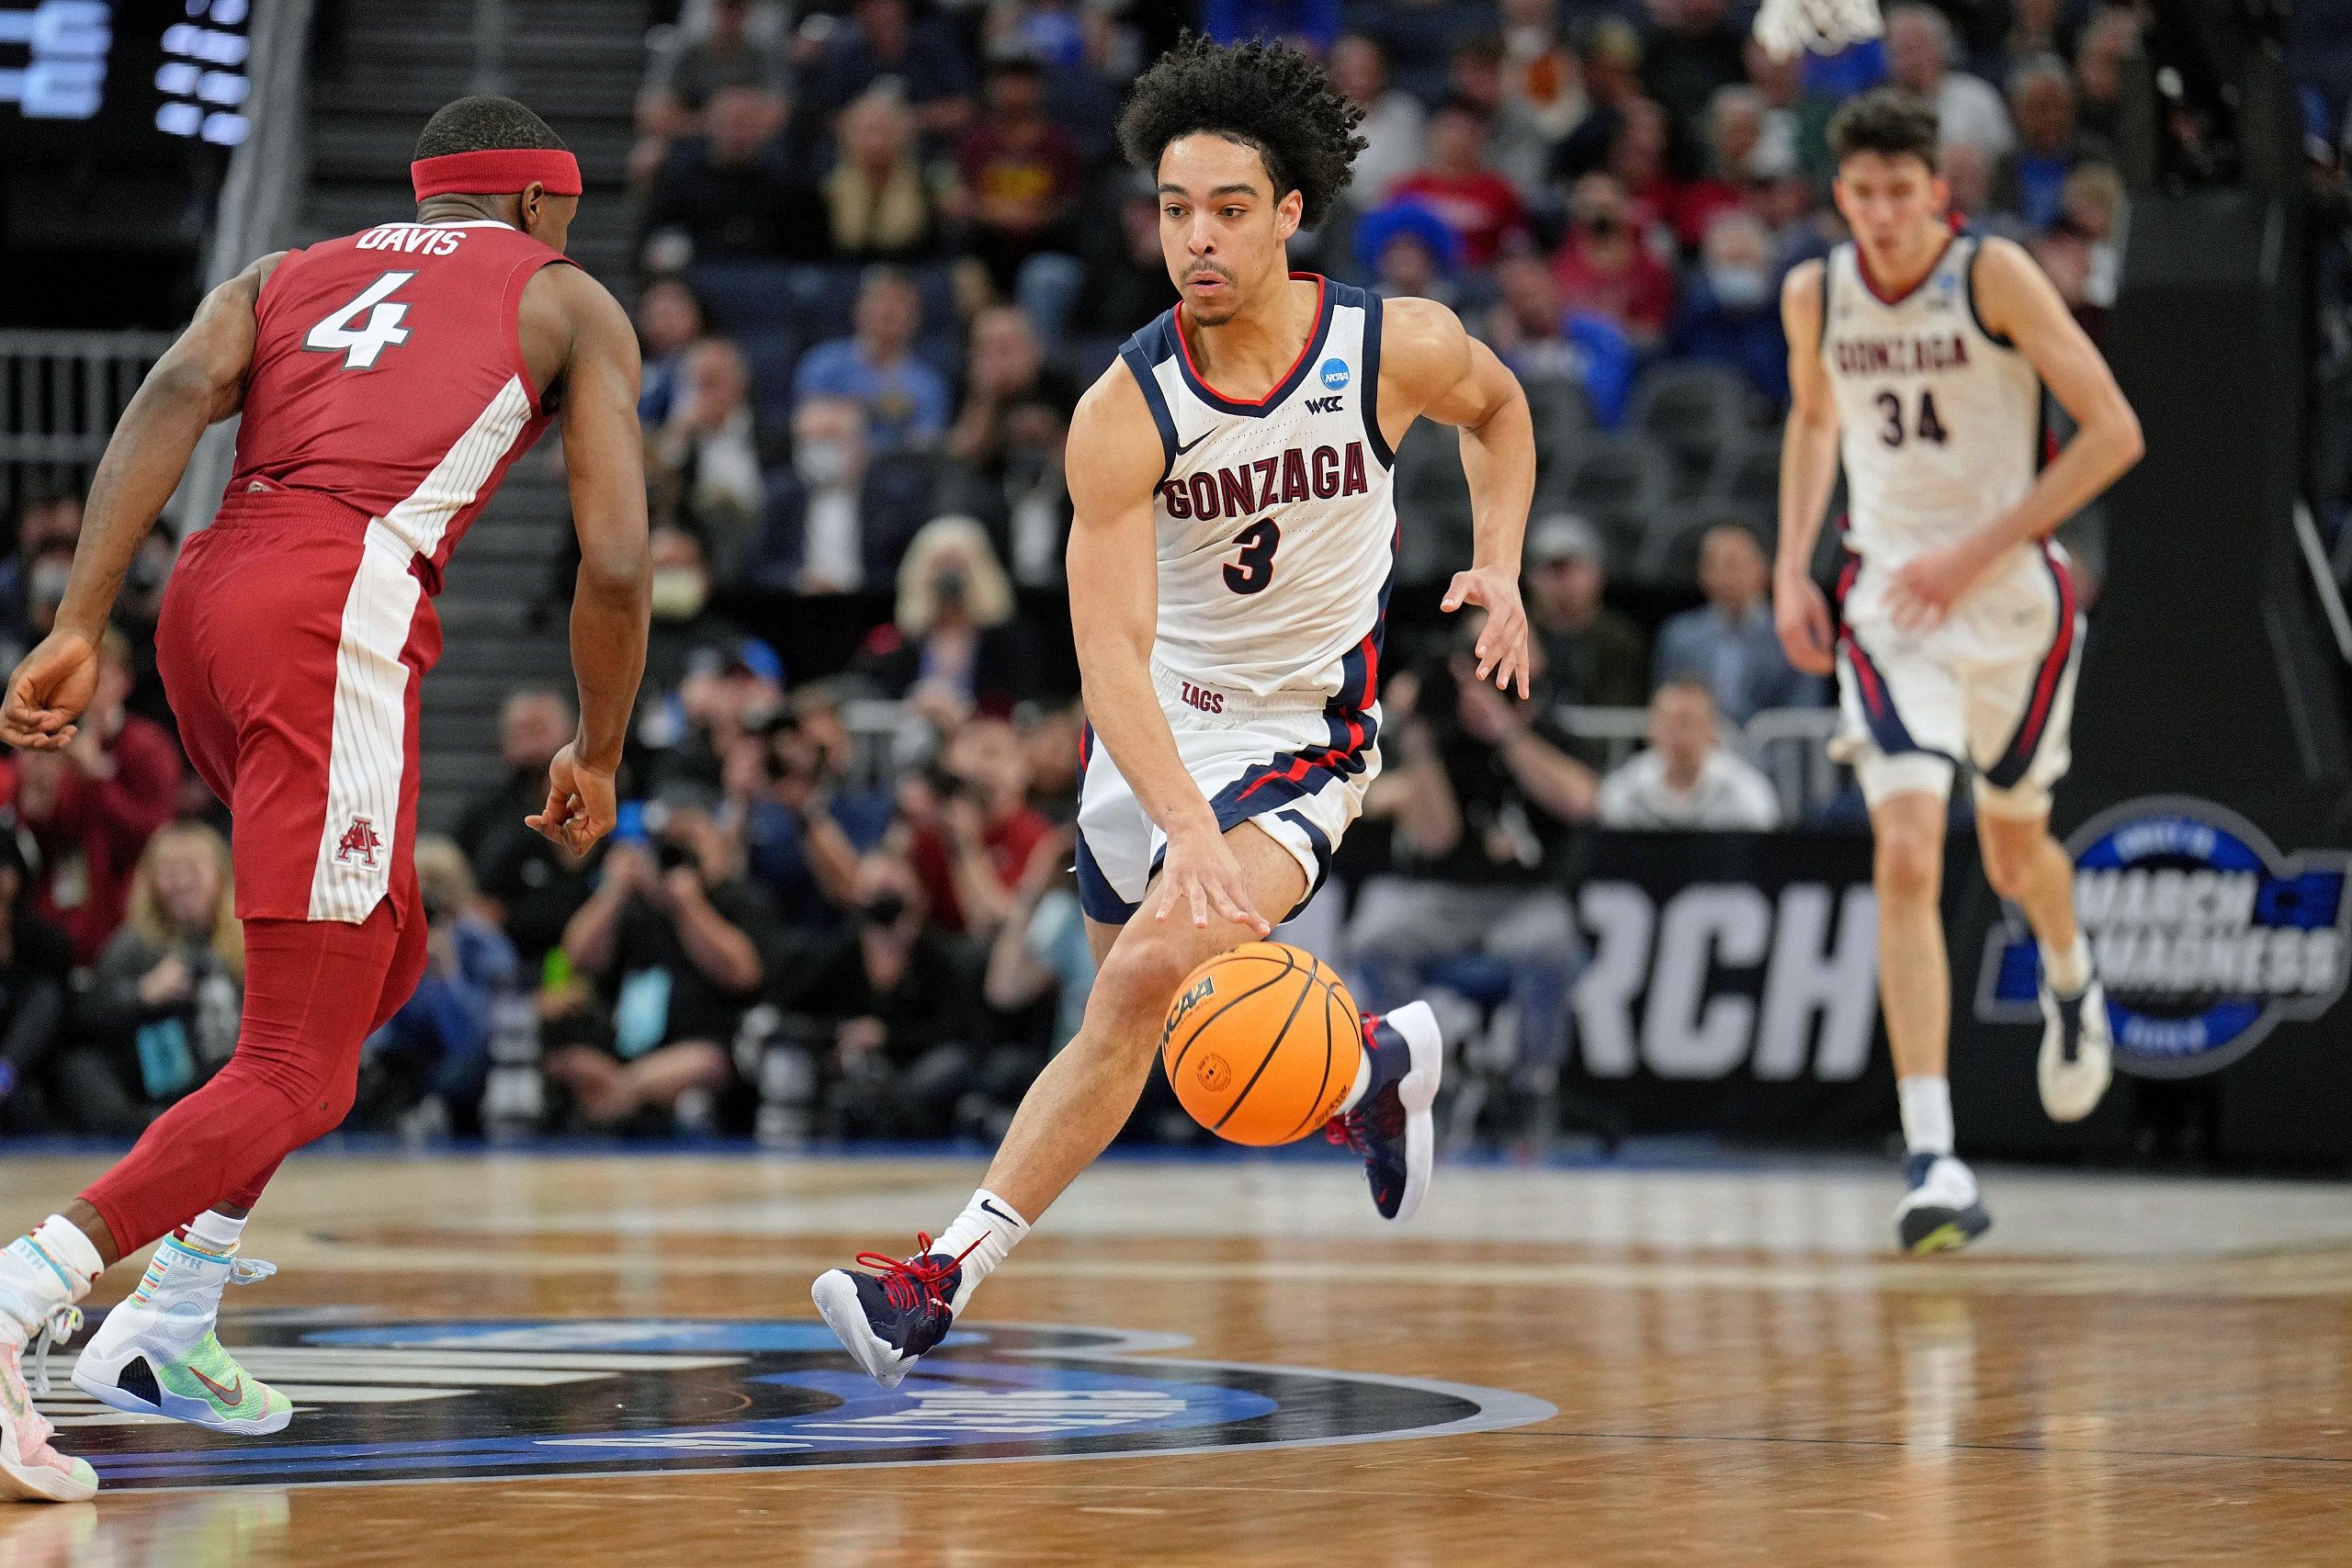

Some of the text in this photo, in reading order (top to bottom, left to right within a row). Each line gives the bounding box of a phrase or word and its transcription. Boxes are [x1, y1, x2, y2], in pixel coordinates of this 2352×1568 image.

[356, 227, 467, 255] DAVIS
[301, 269, 421, 371] 4
[1325, 371, 1350, 383] NCAA
[1837, 334, 1970, 374] GONZAGA
[1305, 395, 1344, 415] WCC
[1874, 389, 1949, 447] 34
[1162, 441, 1368, 521] GONZAGA
[1223, 516, 1281, 595] 3
[1181, 681, 1224, 715] ZAGS
[1573, 877, 1880, 1082] RCH
[1162, 975, 1216, 1049] NCAA
